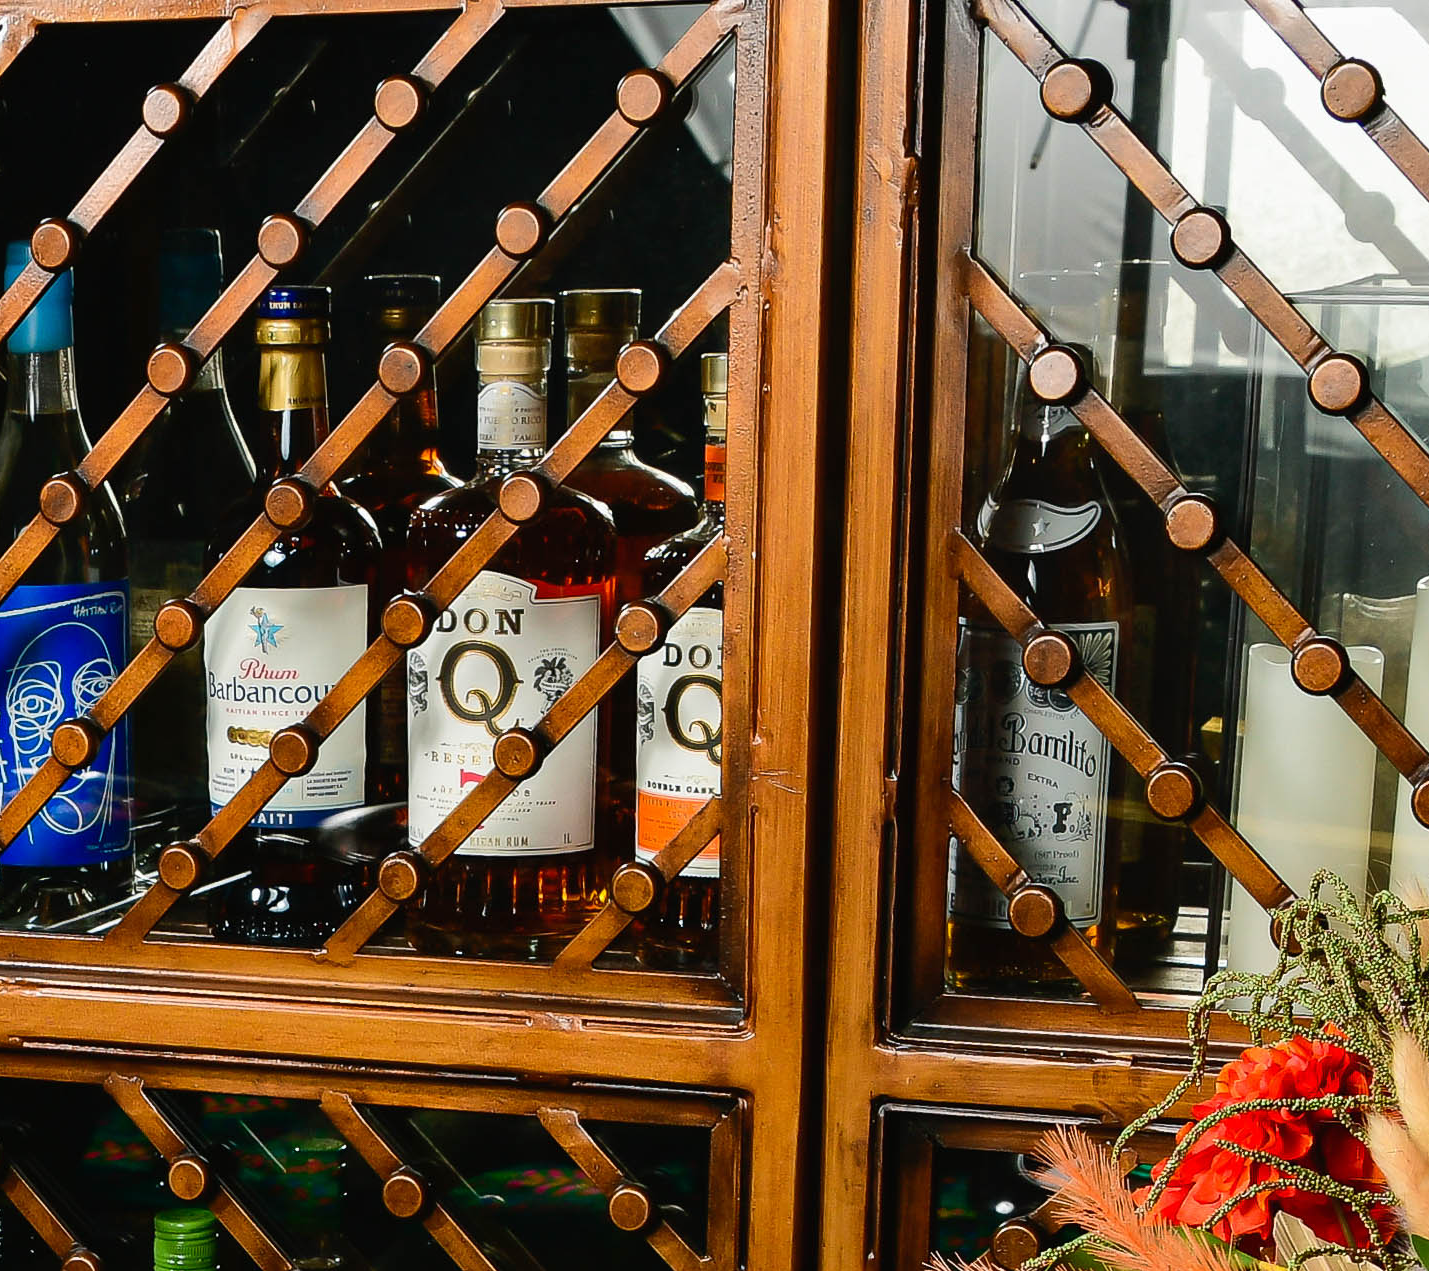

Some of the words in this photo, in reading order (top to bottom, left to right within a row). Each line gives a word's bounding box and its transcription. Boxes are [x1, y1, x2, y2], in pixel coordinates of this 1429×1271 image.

[484, 416, 519, 425] PUEO
[435, 608, 525, 635] DON
[239, 657, 300, 680] Rhum
[208, 671, 336, 704] Barbancou
[435, 639, 525, 738] Q
[226, 707, 258, 716] HAITIAN
[262, 709, 289, 718] SINCE
[661, 674, 722, 766] Q
[998, 711, 1097, 778] Barrilito
[1027, 773, 1059, 789] EXTRA
[250, 813, 294, 825] AITI
[506, 836, 529, 848] RUM
